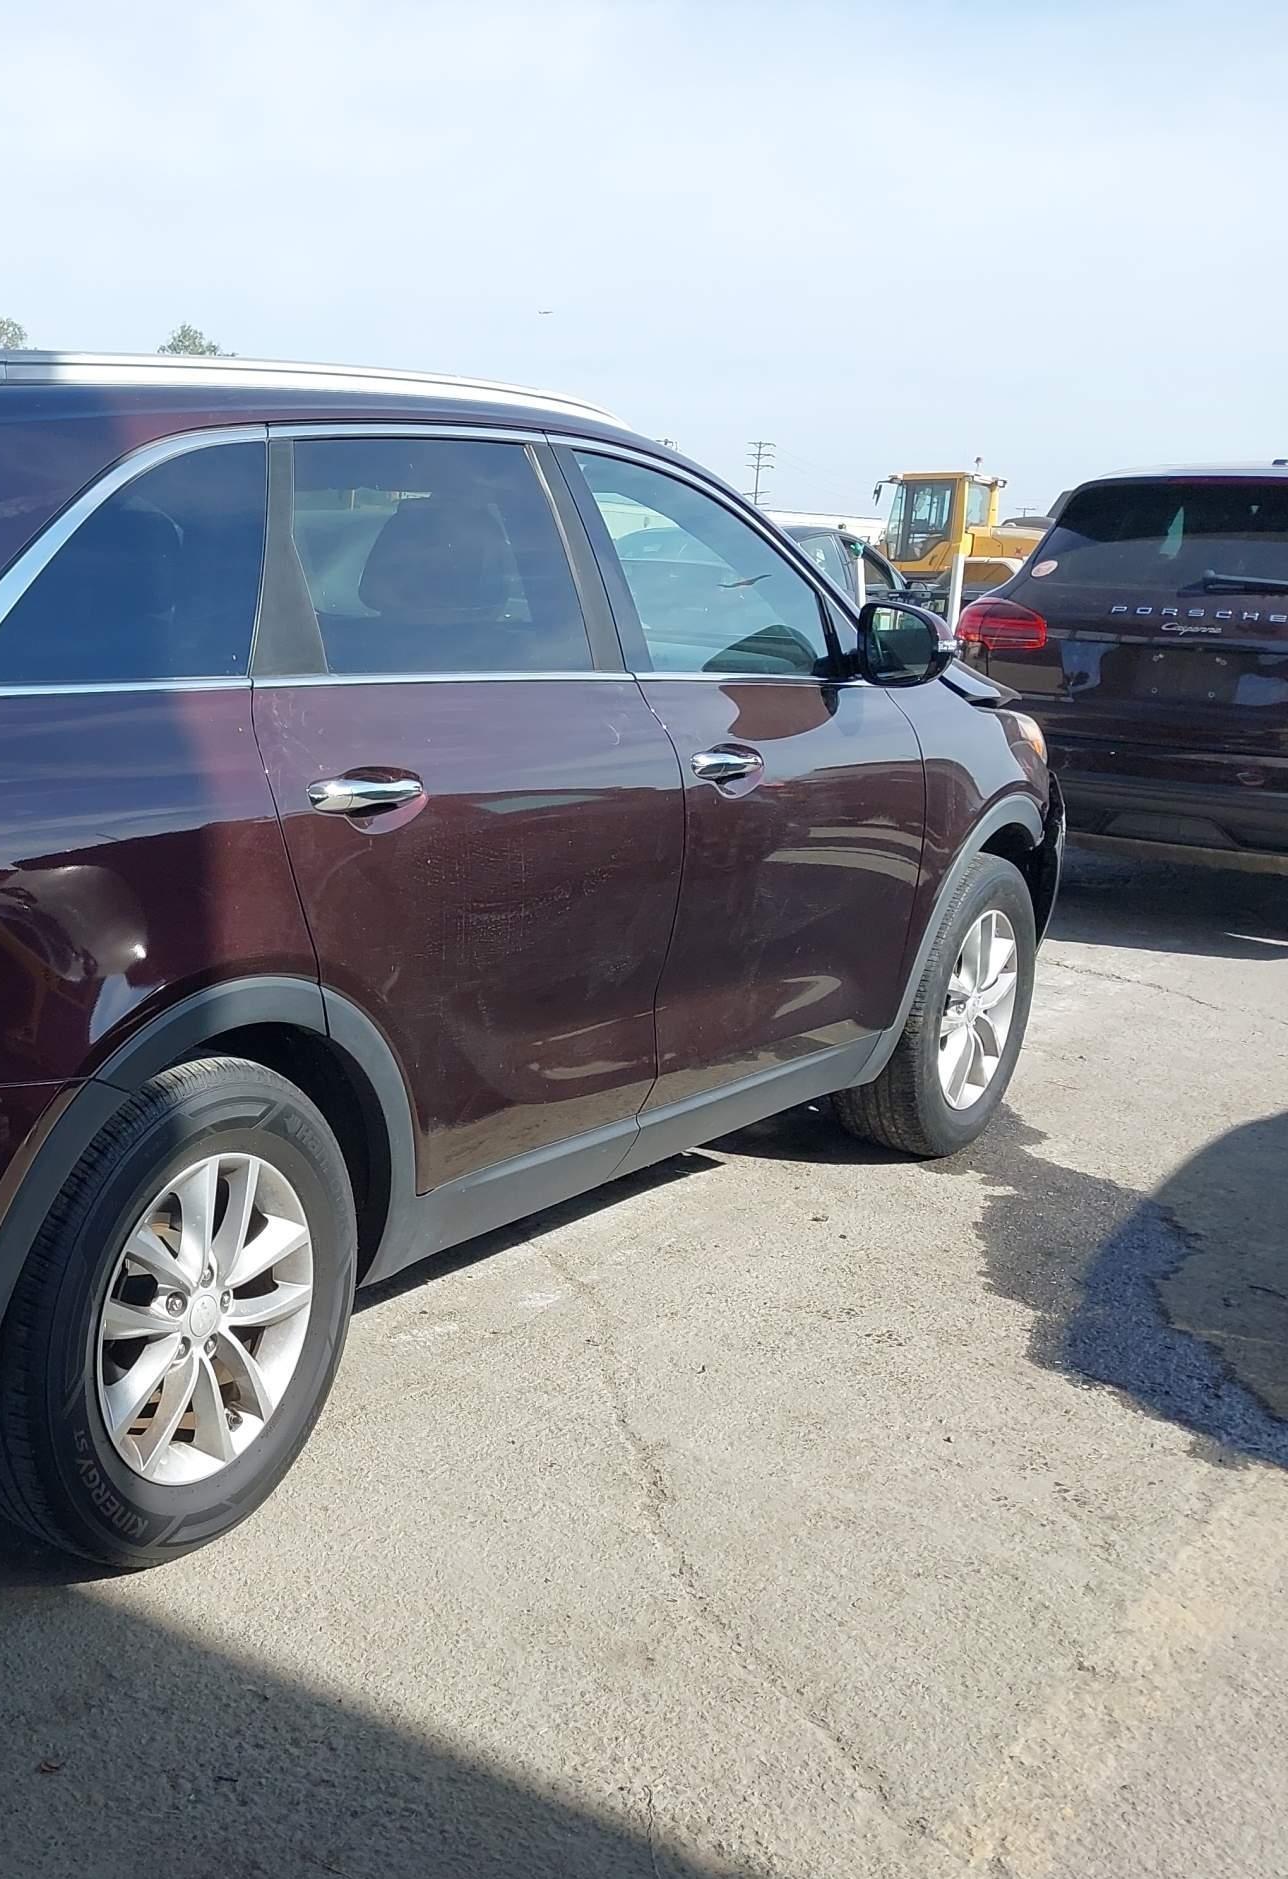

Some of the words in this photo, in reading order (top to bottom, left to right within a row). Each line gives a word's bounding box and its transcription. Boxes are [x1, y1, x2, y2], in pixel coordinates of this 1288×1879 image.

[1111, 605, 1288, 623] PORSCHE
[1162, 622, 1223, 636] Cayenne
[73, 1428, 89, 1453] ST
[76, 1458, 150, 1538] KINERGY
